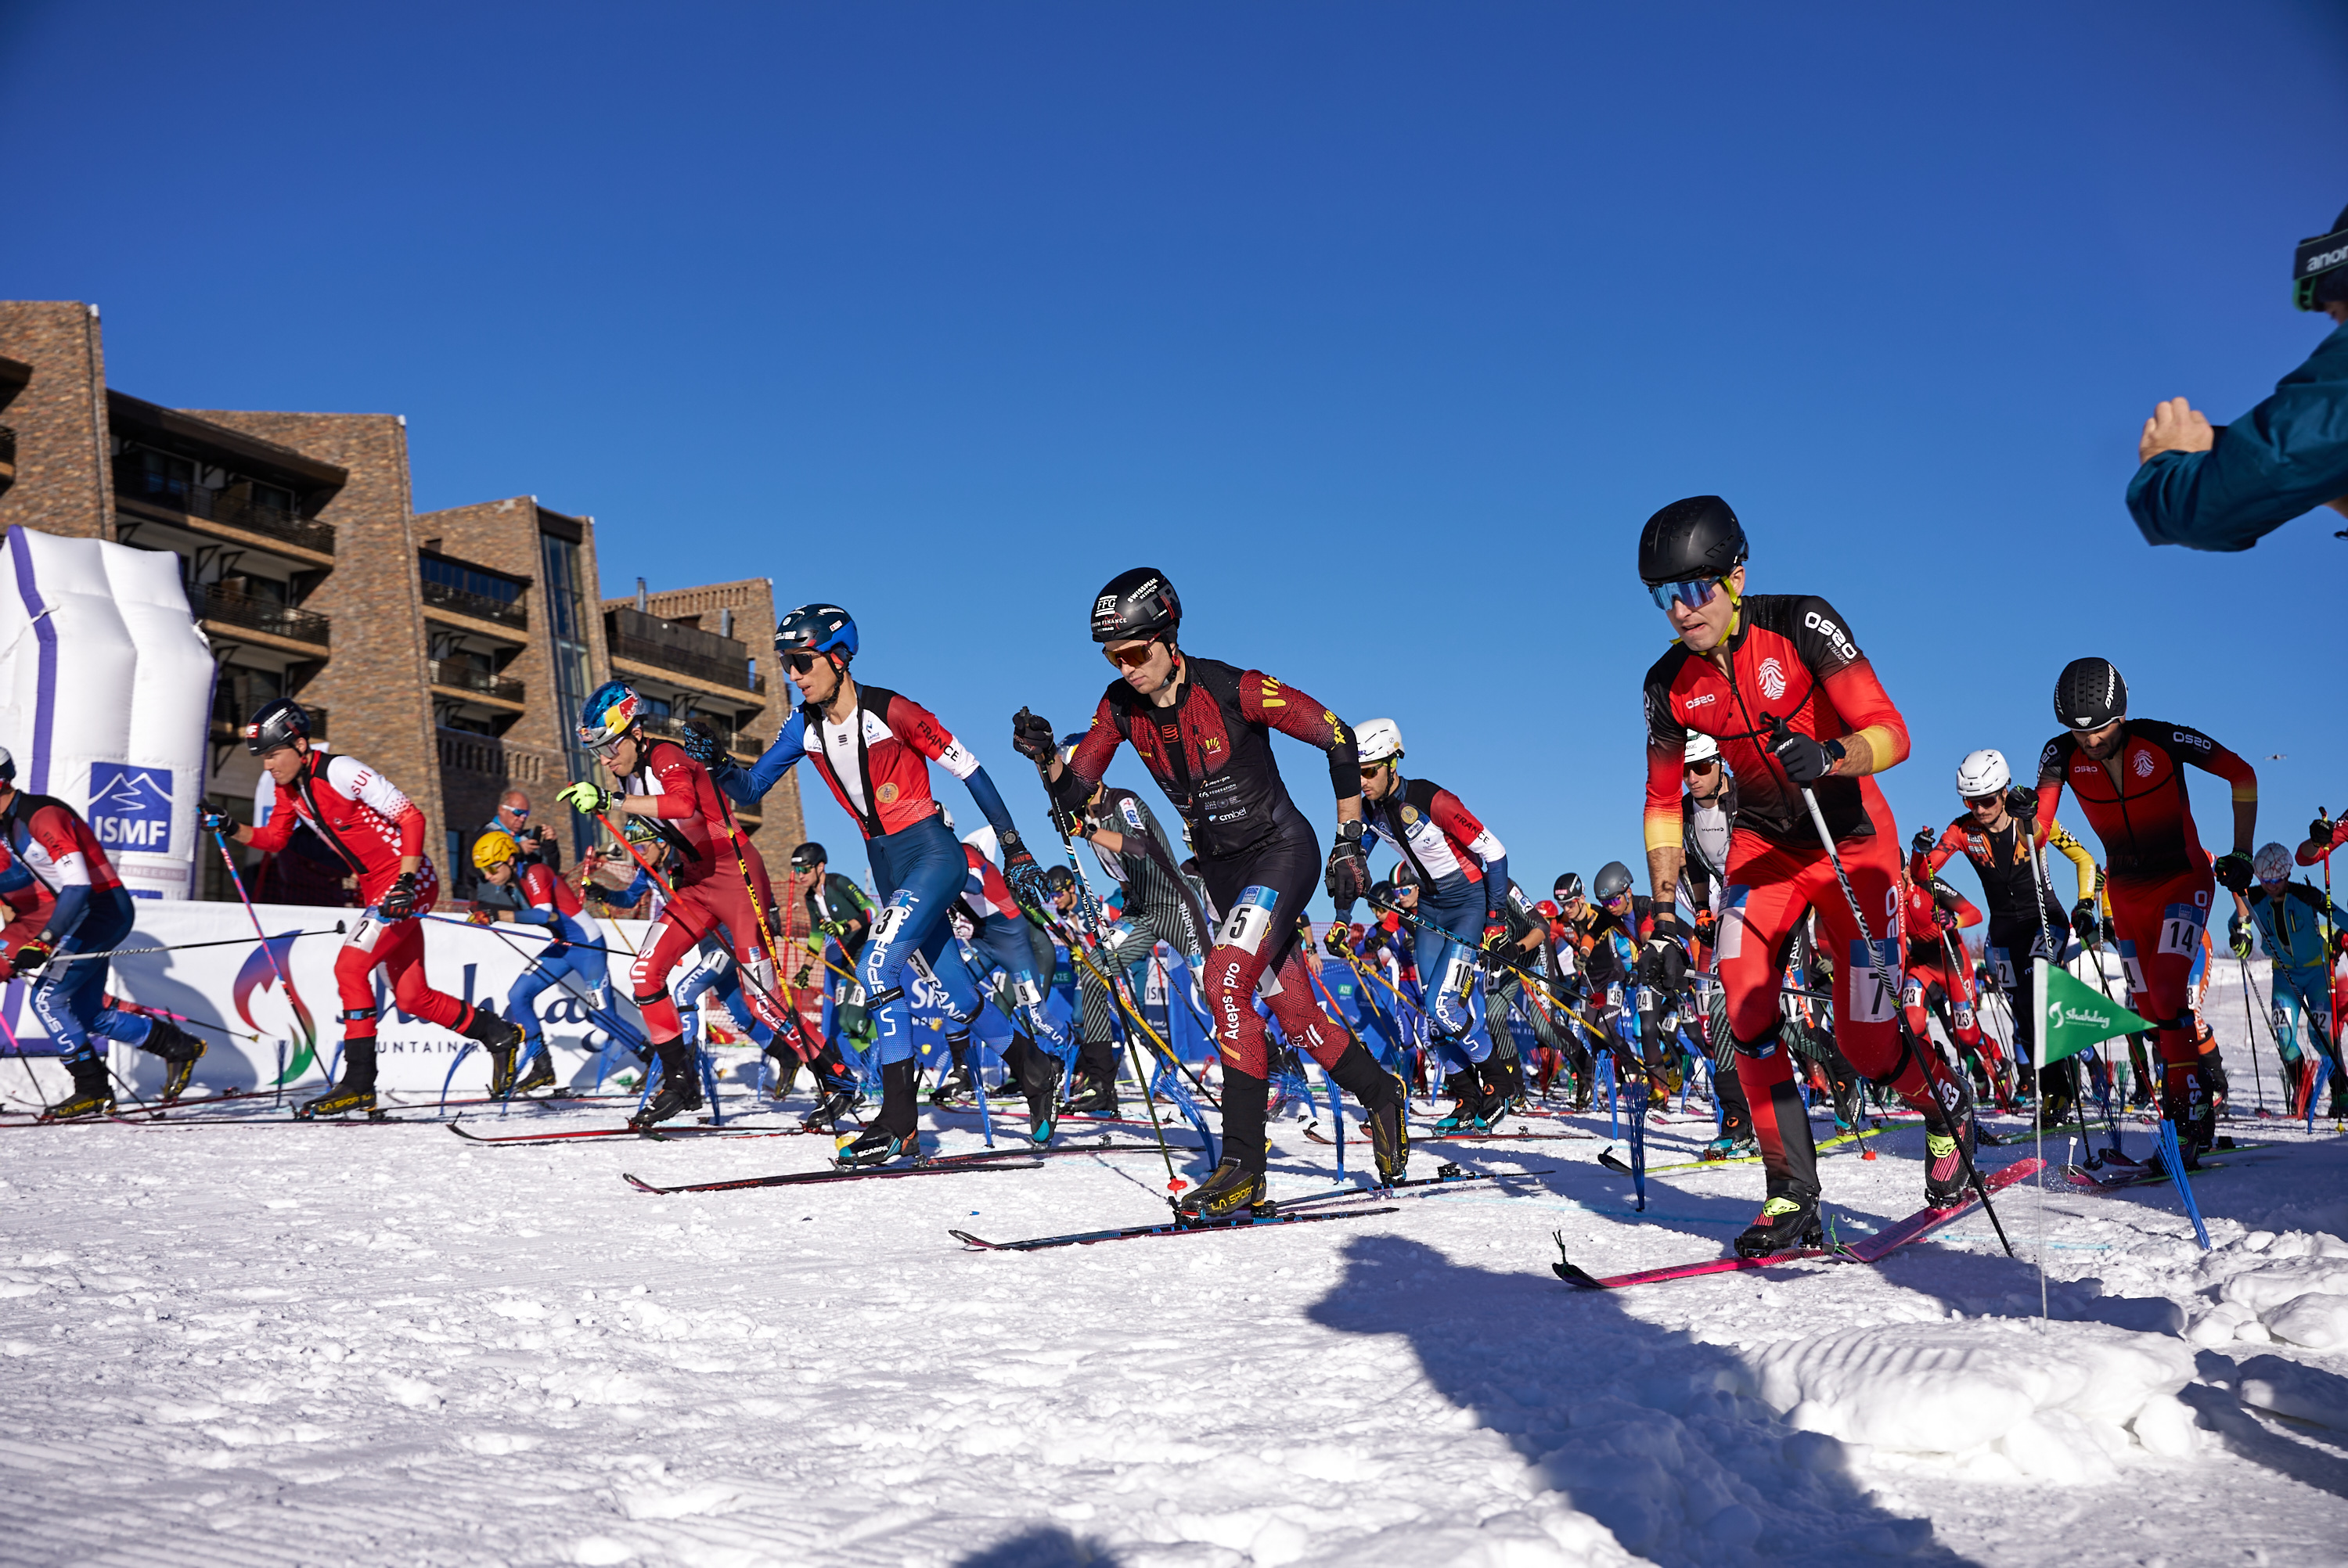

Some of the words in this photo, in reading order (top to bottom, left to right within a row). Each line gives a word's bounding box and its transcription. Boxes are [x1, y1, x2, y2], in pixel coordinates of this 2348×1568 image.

[1127, 577, 1158, 603] SWISSPEAK
[1097, 599, 1116, 610] FFG
[1102, 617, 1127, 626] FINANCE
[2105, 664, 2115, 710] DYNAFIT
[917, 721, 960, 762] FRANCE
[351, 770, 373, 797] SUI
[1209, 783, 1237, 795] FEDERATION
[1219, 807, 1247, 822] cmbel
[93, 815, 167, 846] ISMF
[1453, 813, 1490, 844] FRANCE
[2040, 848, 2053, 892] maloja
[1082, 893, 1096, 933] VERTICAL
[1831, 854, 1878, 951] DYNAFIT
[1896, 879, 1905, 933] FAST&LIGHT
[757, 909, 773, 948] RACE
[875, 908, 893, 935] 3
[1179, 902, 1195, 938] Austria
[1230, 908, 1251, 939] 5
[2036, 881, 2053, 953] DYNAFIT
[358, 919, 371, 942] 2
[2170, 921, 2193, 952] 14
[1189, 938, 1201, 956] Ski
[631, 948, 654, 984] SUI
[708, 951, 720, 968] 11
[910, 954, 928, 978] 3
[677, 964, 711, 1008] SPORTIV
[1053, 973, 1069, 982] AZE
[1223, 962, 1240, 989] pro
[1454, 963, 1471, 987] 10
[1460, 975, 1473, 998] CHINA
[1020, 984, 1031, 1002] 9
[1146, 987, 1169, 1001] ISM
[1339, 985, 1351, 994] AZE
[1611, 990, 1620, 1004] 35
[1868, 973, 1885, 1015] 7
[1903, 989, 1916, 1003] 23
[1637, 994, 1648, 1009] 24
[680, 1014, 692, 1031] LA
[880, 1006, 896, 1038] LA
[1223, 995, 1239, 1040] Adeps
[1663, 1018, 1673, 1030] 48
[1957, 1012, 1970, 1027] 23
[2065, 1008, 2110, 1029] Shahdag
[2273, 1009, 2285, 1025] 32
[56, 1033, 76, 1053] LA
[787, 1028, 805, 1048] LA
[1050, 1031, 1064, 1045] LA
[1462, 1034, 1479, 1052] LA
[2187, 1073, 2202, 1120] ESP
[1486, 1106, 1504, 1124] SCARPA
[857, 1145, 889, 1158] SCARPA
[1400, 1149, 1407, 1164] LA
[1211, 1199, 1227, 1210] LA
